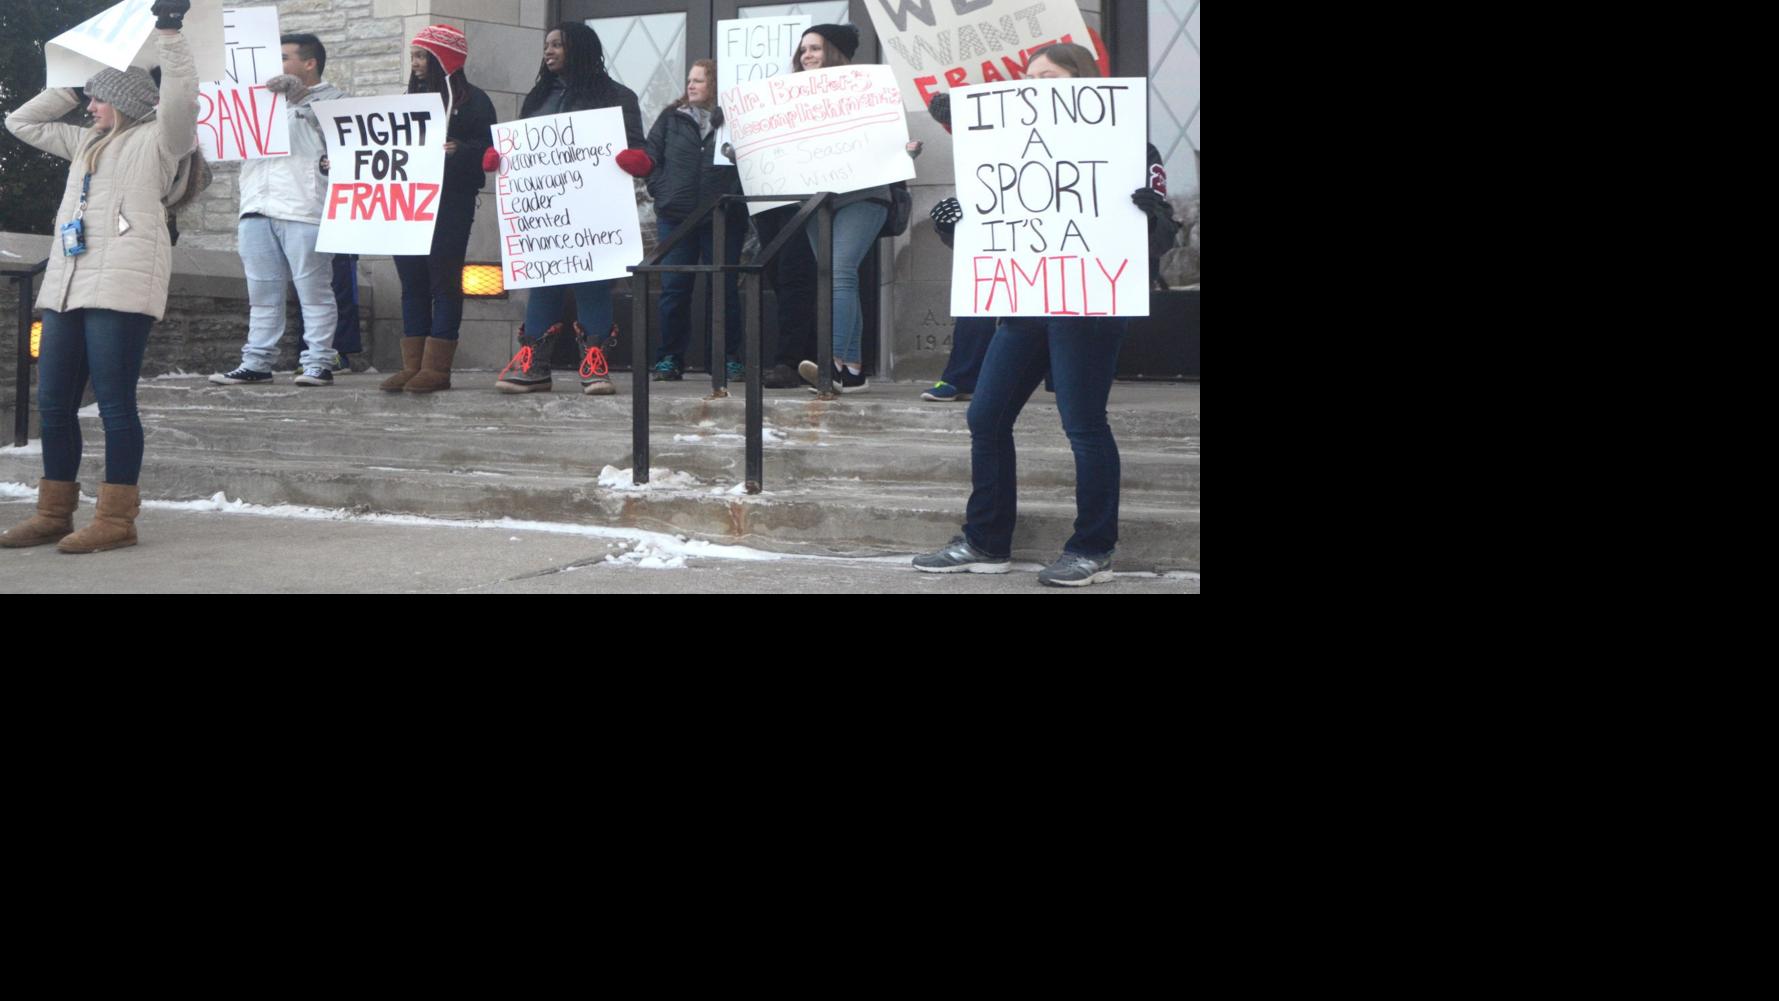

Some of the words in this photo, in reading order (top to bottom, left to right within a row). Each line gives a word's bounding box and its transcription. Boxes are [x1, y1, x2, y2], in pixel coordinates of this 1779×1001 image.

[727, 23, 801, 58] FIGHT
[888, 2, 1047, 71] WANT
[196, 86, 289, 159] RANZ
[966, 87, 1039, 130] IT'S
[1051, 85, 1129, 126] NOT
[333, 111, 431, 146] FIGHT
[497, 127, 521, 155] Be
[525, 116, 575, 151] bold
[1021, 128, 1052, 159] A
[354, 149, 409, 181] FOR
[550, 142, 613, 167] challenges
[498, 170, 584, 196] Encouraging
[975, 160, 1108, 217] SPORT
[327, 182, 440, 222] FRANZ
[500, 191, 556, 215] Leader
[504, 208, 571, 233] Talented
[981, 217, 1048, 253] IT'S
[1060, 219, 1091, 252] A
[506, 234, 574, 256] Enhance
[574, 228, 623, 248] others
[511, 252, 594, 283] Respectful
[973, 255, 1129, 316] FAMILY
